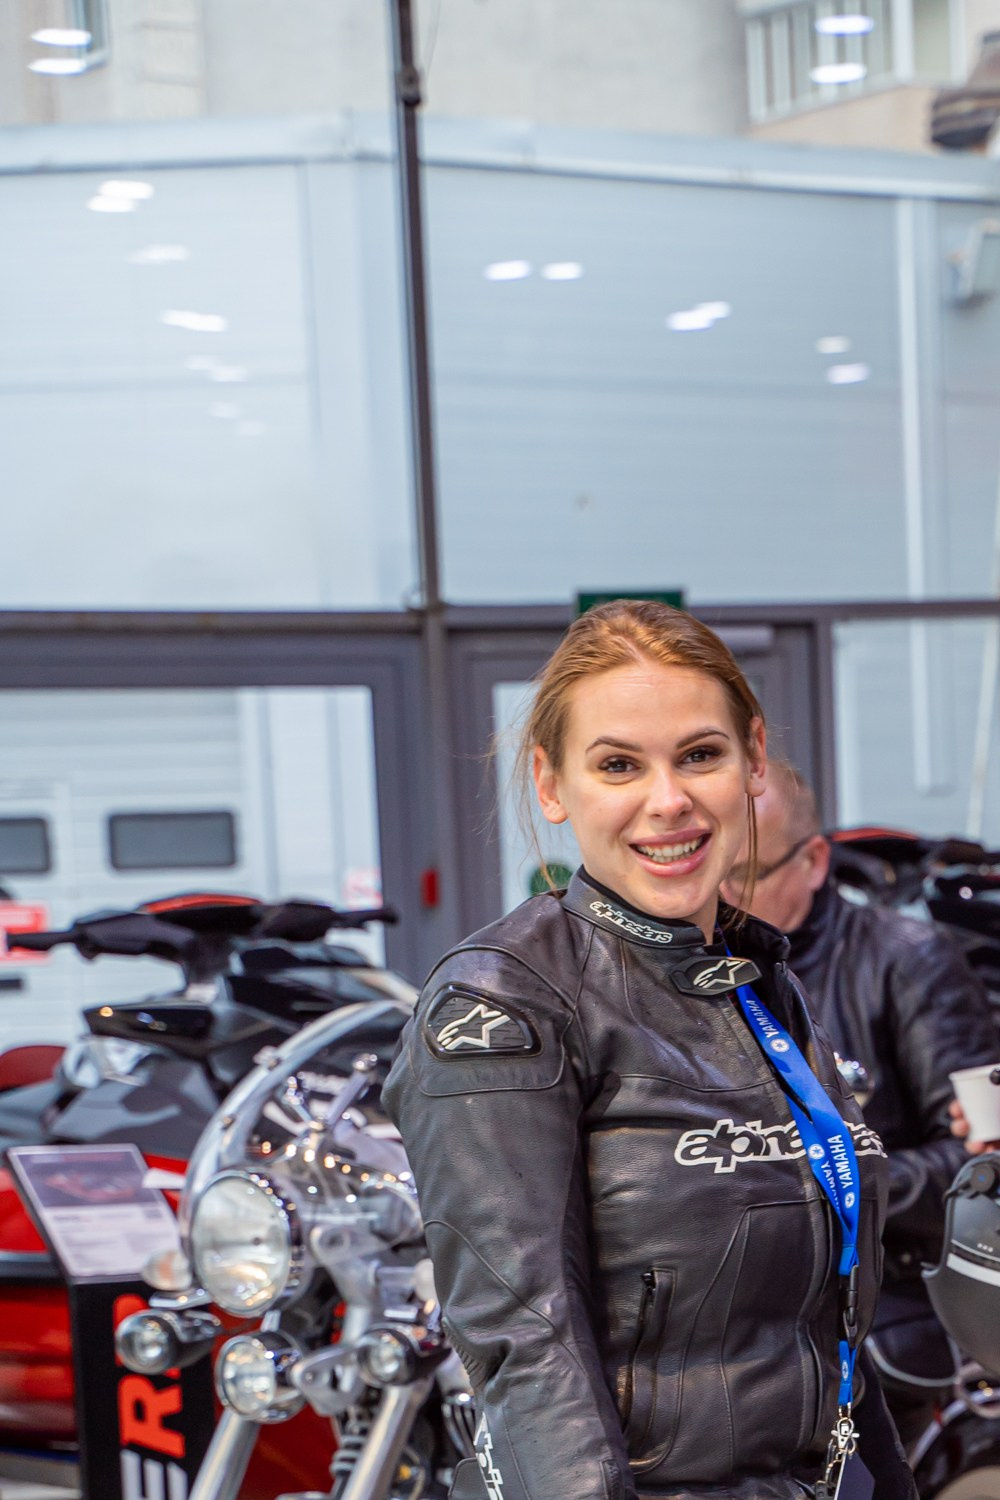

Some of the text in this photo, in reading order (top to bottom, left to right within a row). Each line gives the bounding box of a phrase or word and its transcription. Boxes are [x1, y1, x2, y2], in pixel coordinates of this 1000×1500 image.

[589, 901, 673, 944] alpinestars
[745, 999, 780, 1038] YAMAHA
[827, 1134, 854, 1189] YAMAHA
[820, 1160, 842, 1211] YAM
